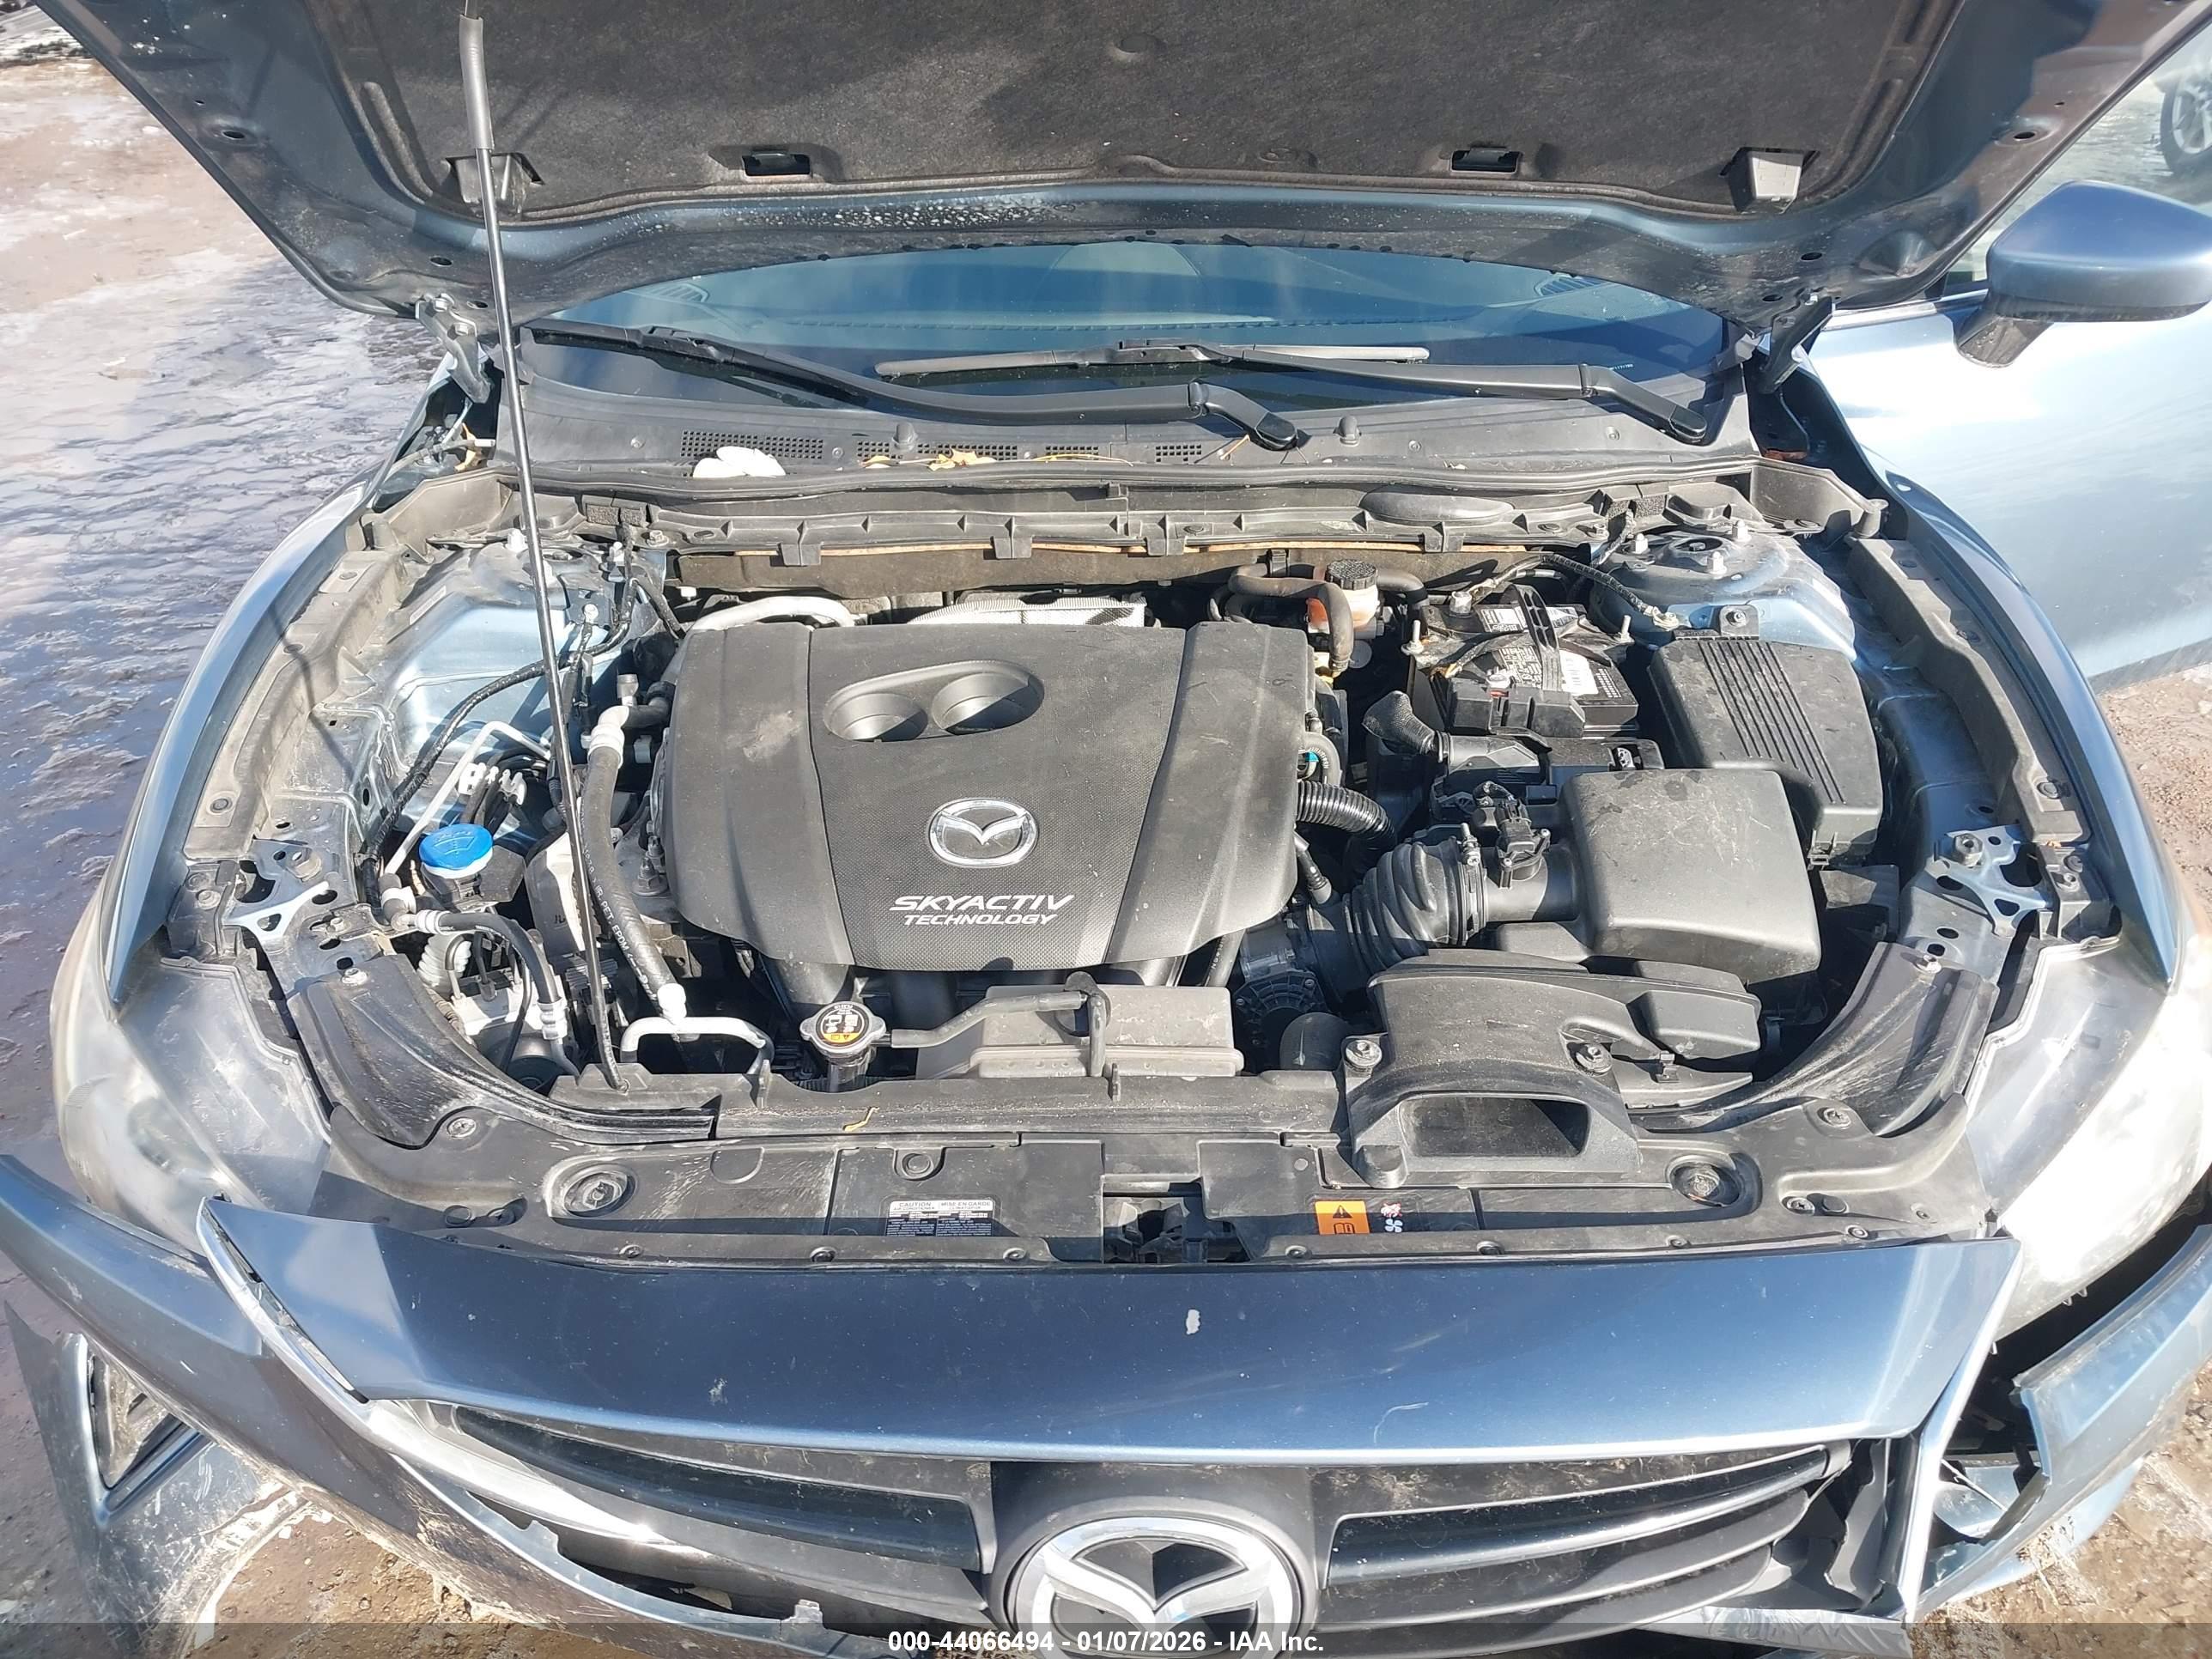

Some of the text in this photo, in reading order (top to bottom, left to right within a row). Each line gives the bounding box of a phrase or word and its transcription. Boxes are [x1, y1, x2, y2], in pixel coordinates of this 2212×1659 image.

[889, 894, 1075, 911] SKYACTIV
[903, 914, 1058, 926] TECHNOLOGY
[611, 924, 629, 951] EPDM
